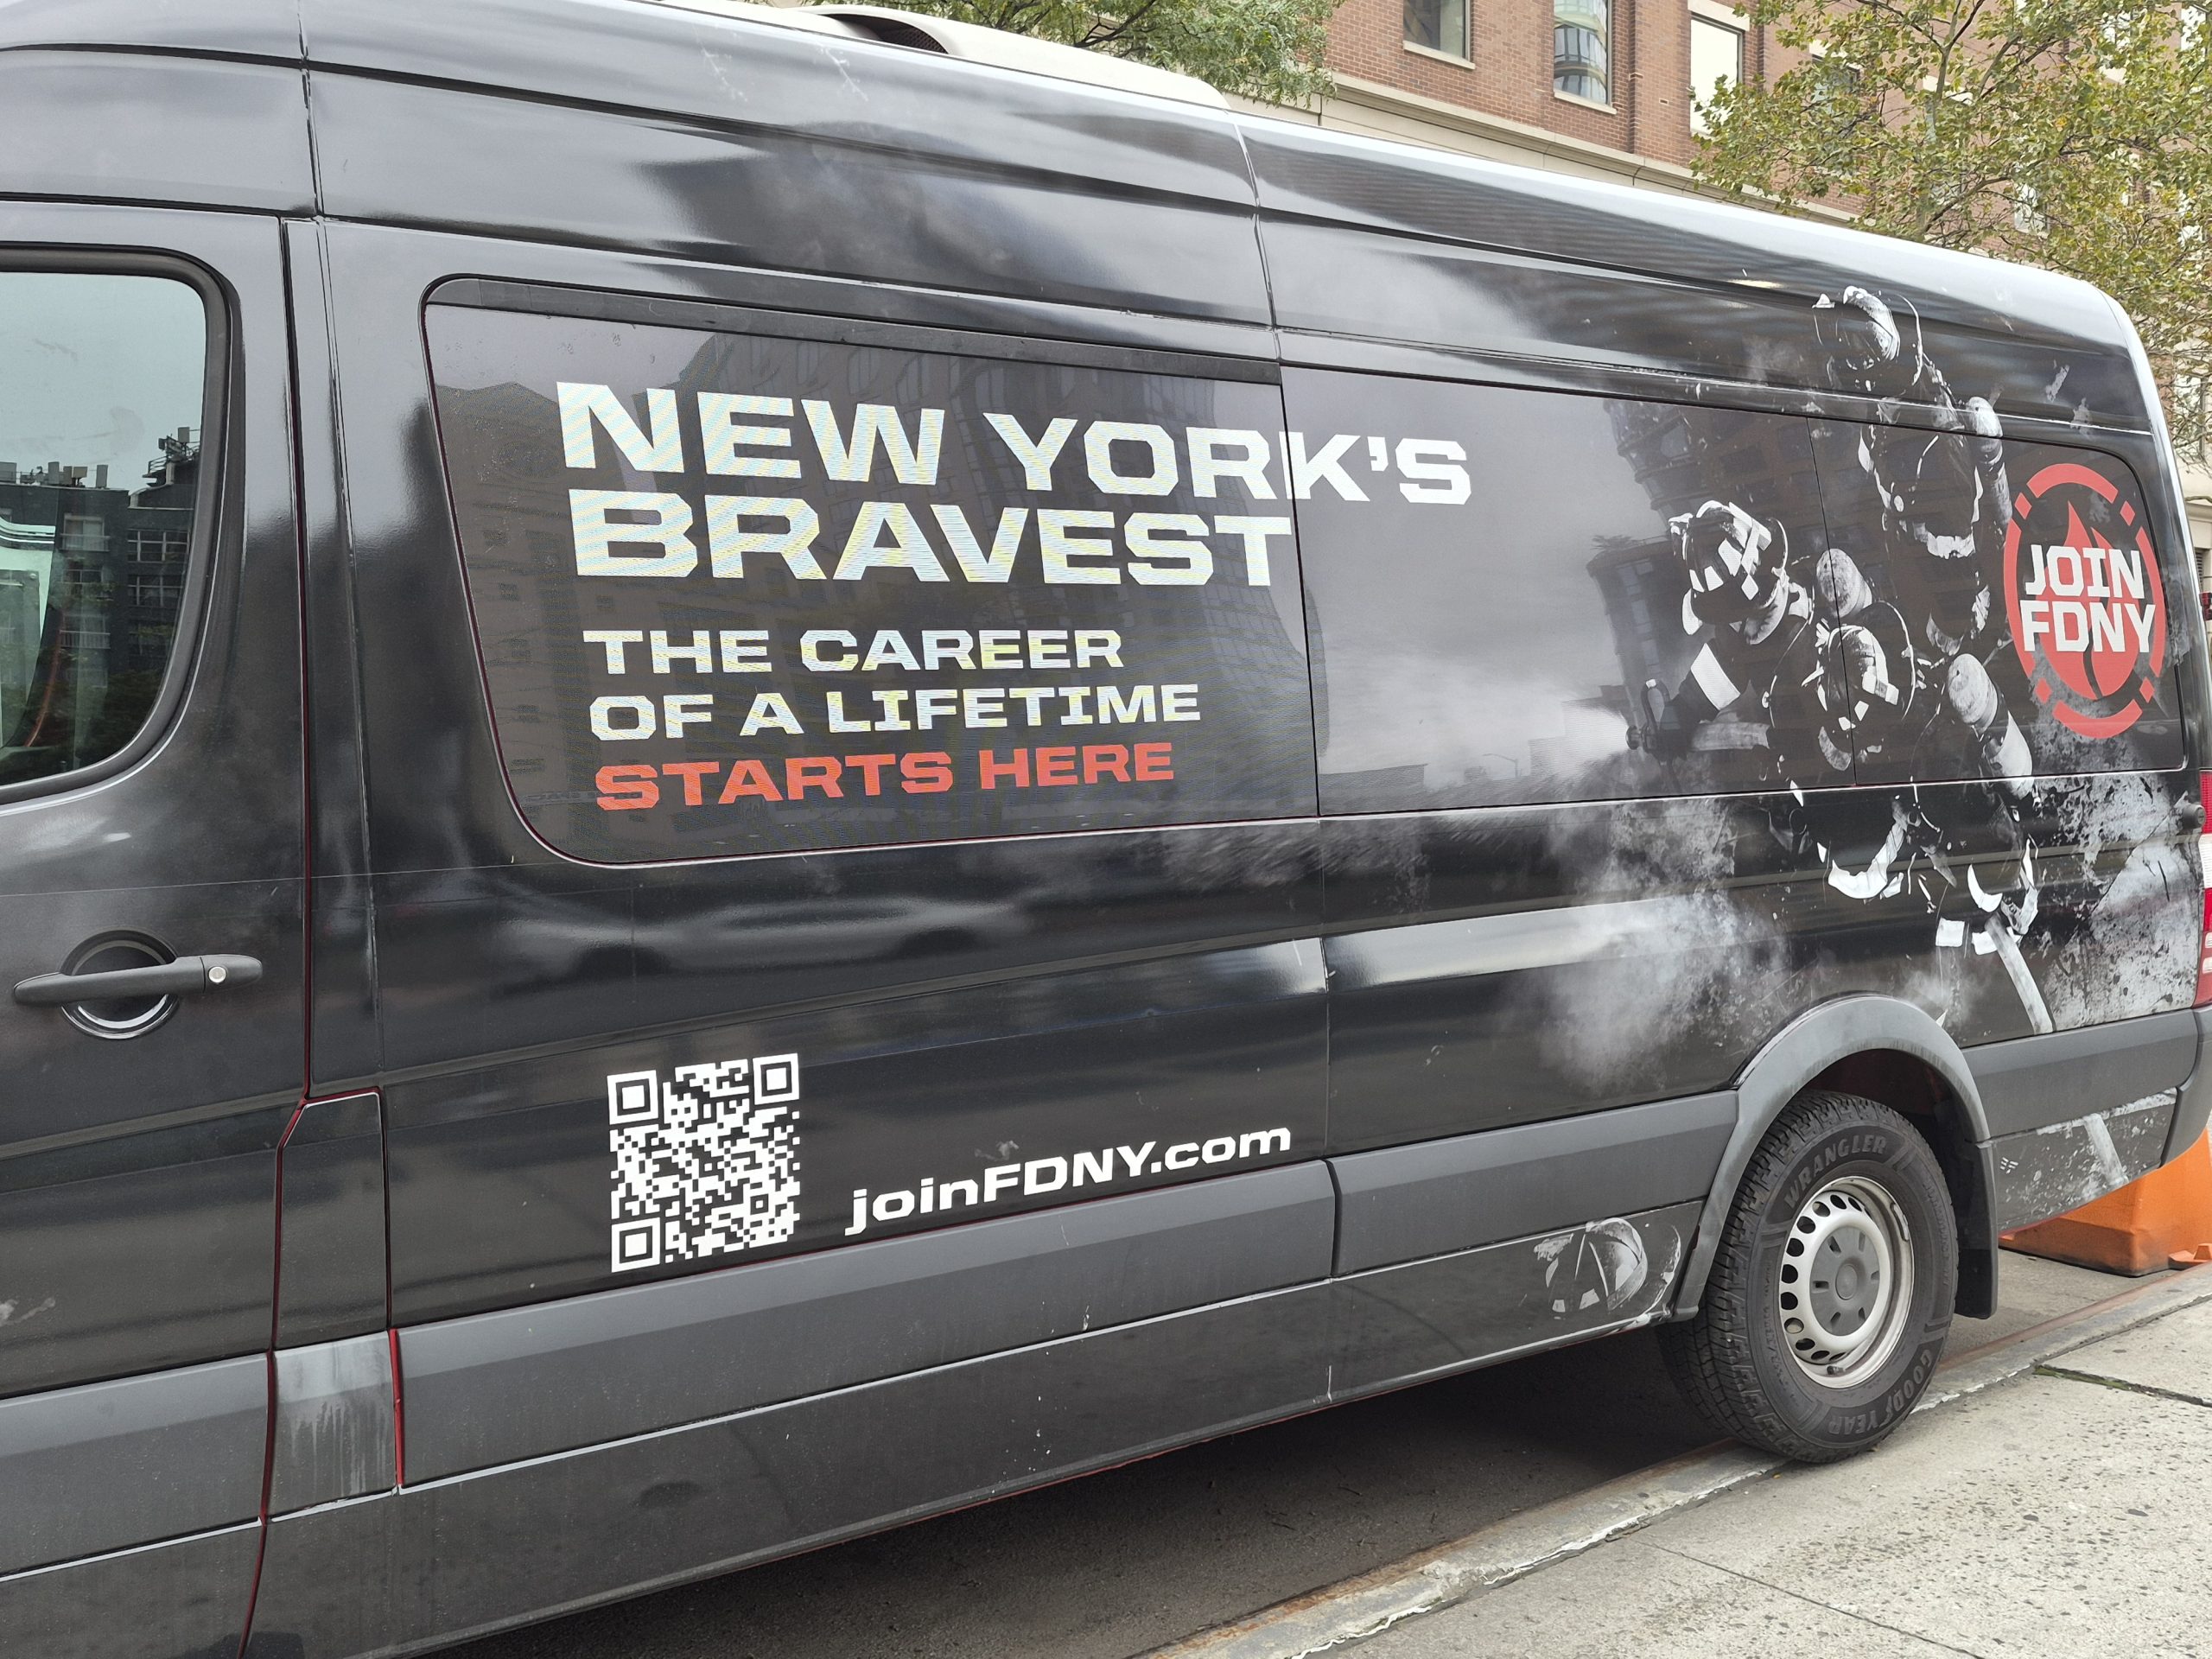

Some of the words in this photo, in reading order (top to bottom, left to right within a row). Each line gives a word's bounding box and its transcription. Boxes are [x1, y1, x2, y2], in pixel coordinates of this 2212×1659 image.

[556, 381, 944, 486] NEW
[983, 413, 1471, 505] YORK'S
[569, 489, 1292, 587] BRAVEST
[2025, 544, 2145, 599] JOIN
[583, 630, 772, 674] THE
[799, 629, 1123, 671] CAREER
[2020, 600, 2156, 653] FDNY
[589, 694, 714, 741] OF
[740, 692, 804, 736] A
[826, 683, 1201, 734] LIFETIME
[595, 751, 954, 810] STARTS
[978, 742, 1174, 790] HERE
[844, 1127, 1292, 1236] joinFDNY.com
[1784, 1135, 1887, 1209] WRANGLER
